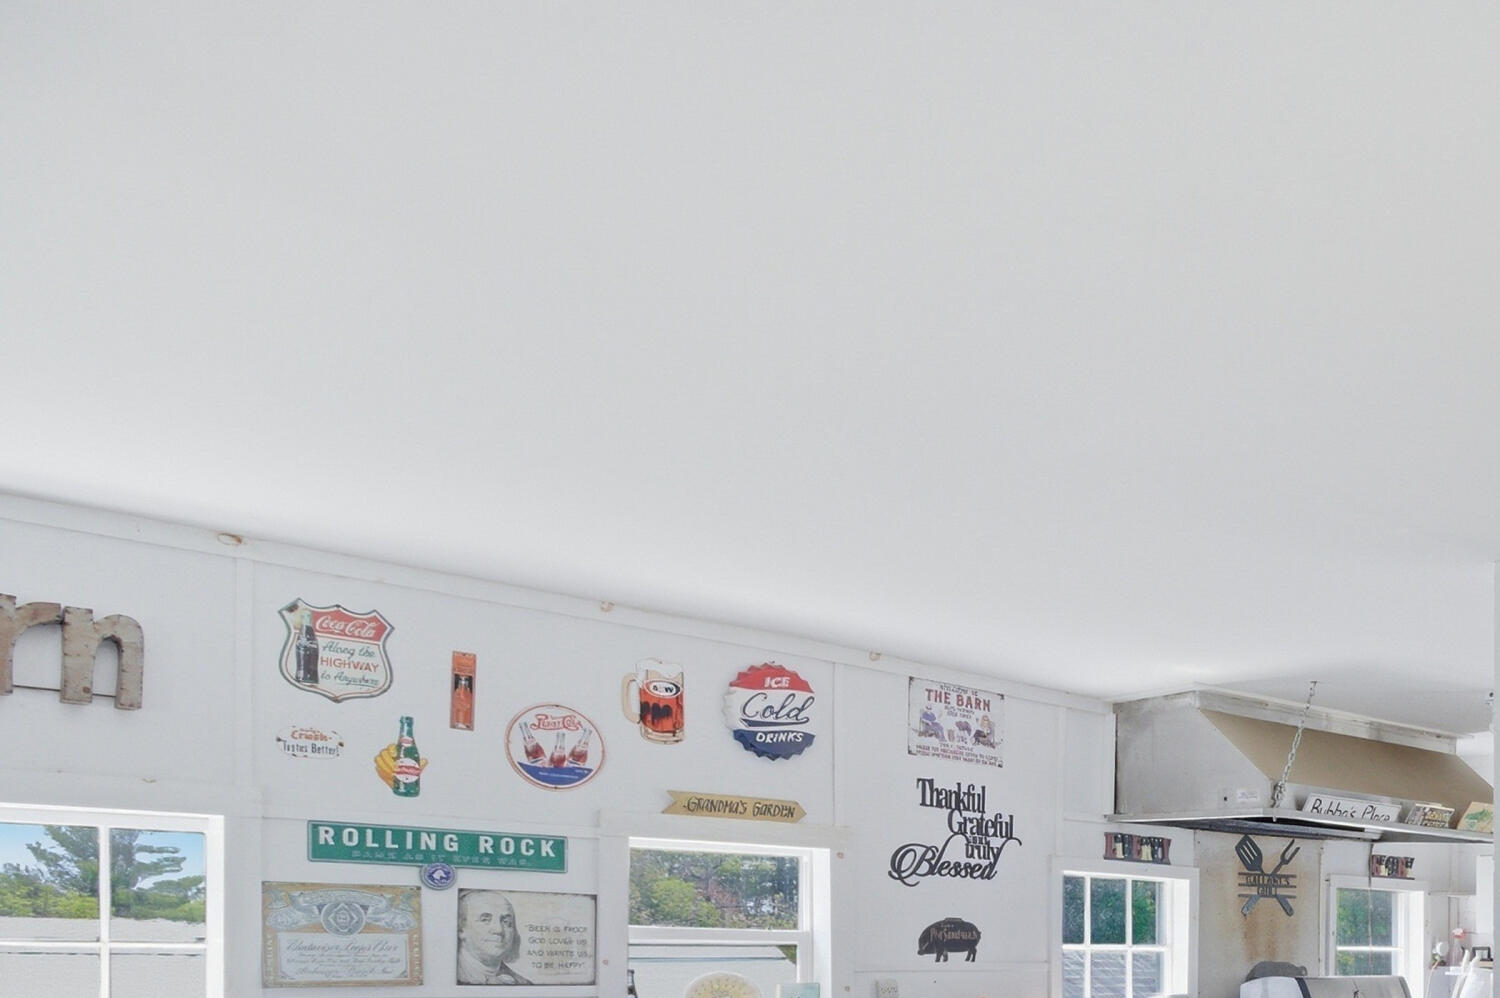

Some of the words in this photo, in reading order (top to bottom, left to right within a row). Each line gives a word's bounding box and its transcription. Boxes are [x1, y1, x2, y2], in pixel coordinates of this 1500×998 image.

[320, 657, 379, 673] HIGHWAY
[763, 676, 791, 688] ICE
[742, 692, 816, 721] Cold
[925, 688, 951, 705] THE
[956, 694, 991, 713] BARN
[755, 731, 804, 743] DRINKS
[916, 778, 986, 814] Thankful
[947, 808, 1014, 839] Grateful
[318, 825, 459, 852] ROLLING
[479, 835, 556, 858] ROCK
[964, 840, 1000, 861] truly
[888, 832, 1022, 887] Blessed
